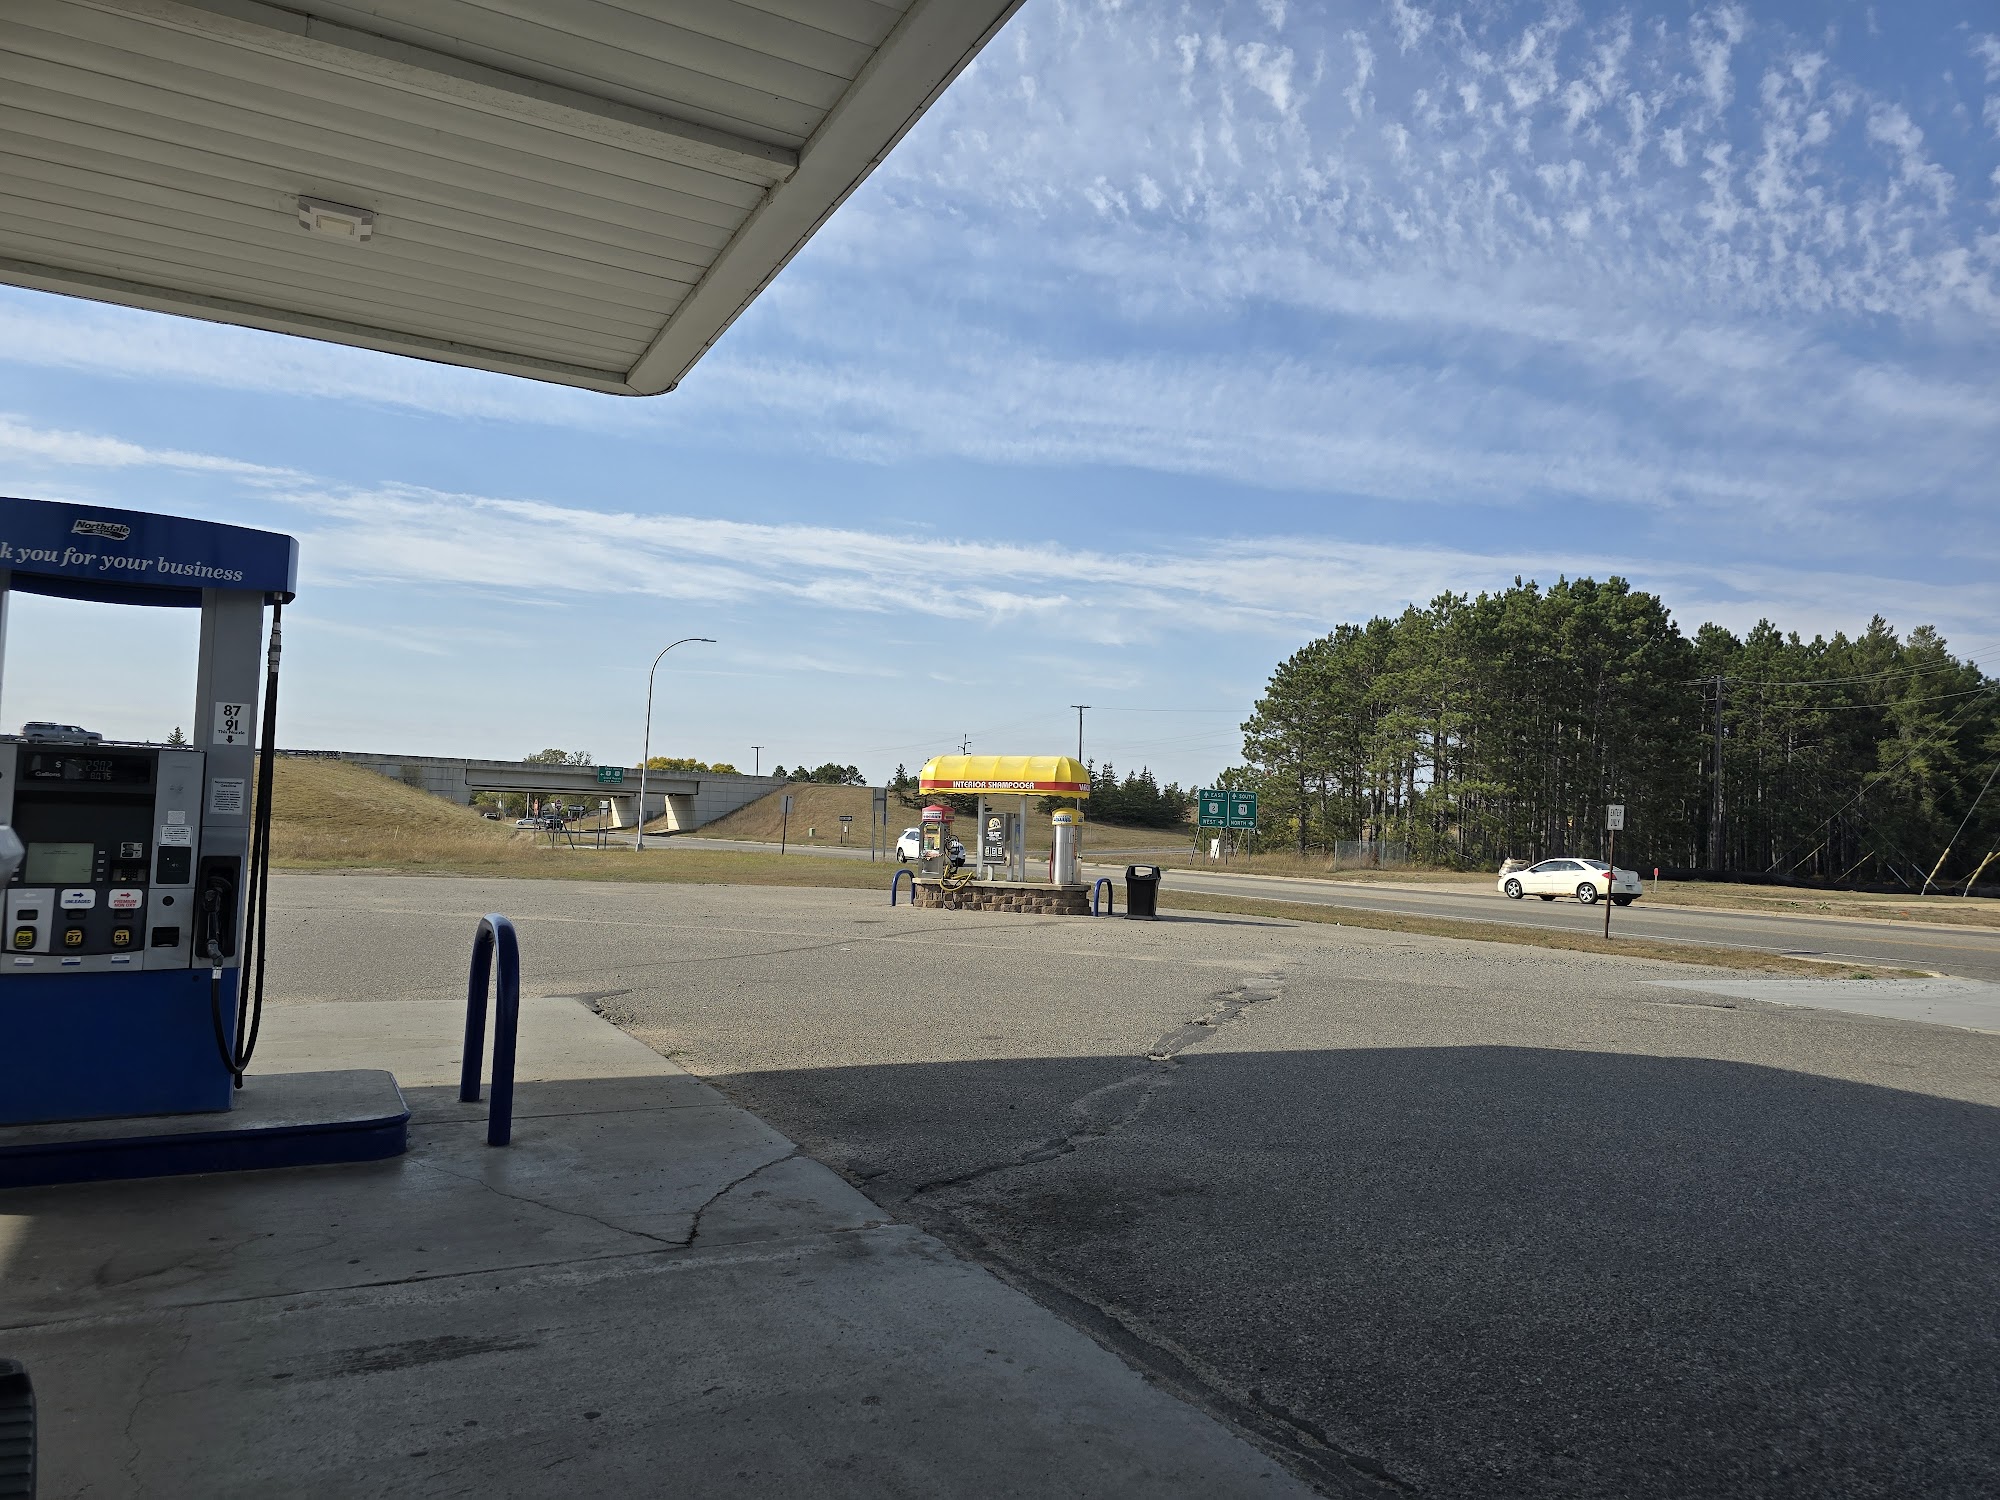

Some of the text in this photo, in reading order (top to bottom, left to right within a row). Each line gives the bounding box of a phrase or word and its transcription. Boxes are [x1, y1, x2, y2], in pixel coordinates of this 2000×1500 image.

[75, 521, 129, 534] Northdale
[15, 548, 58, 563] you
[59, 547, 97, 567] for
[99, 554, 153, 571] your
[157, 557, 243, 581] business
[224, 705, 242, 716] 87
[225, 720, 239, 731] 91
[953, 781, 986, 789] INTERIOR
